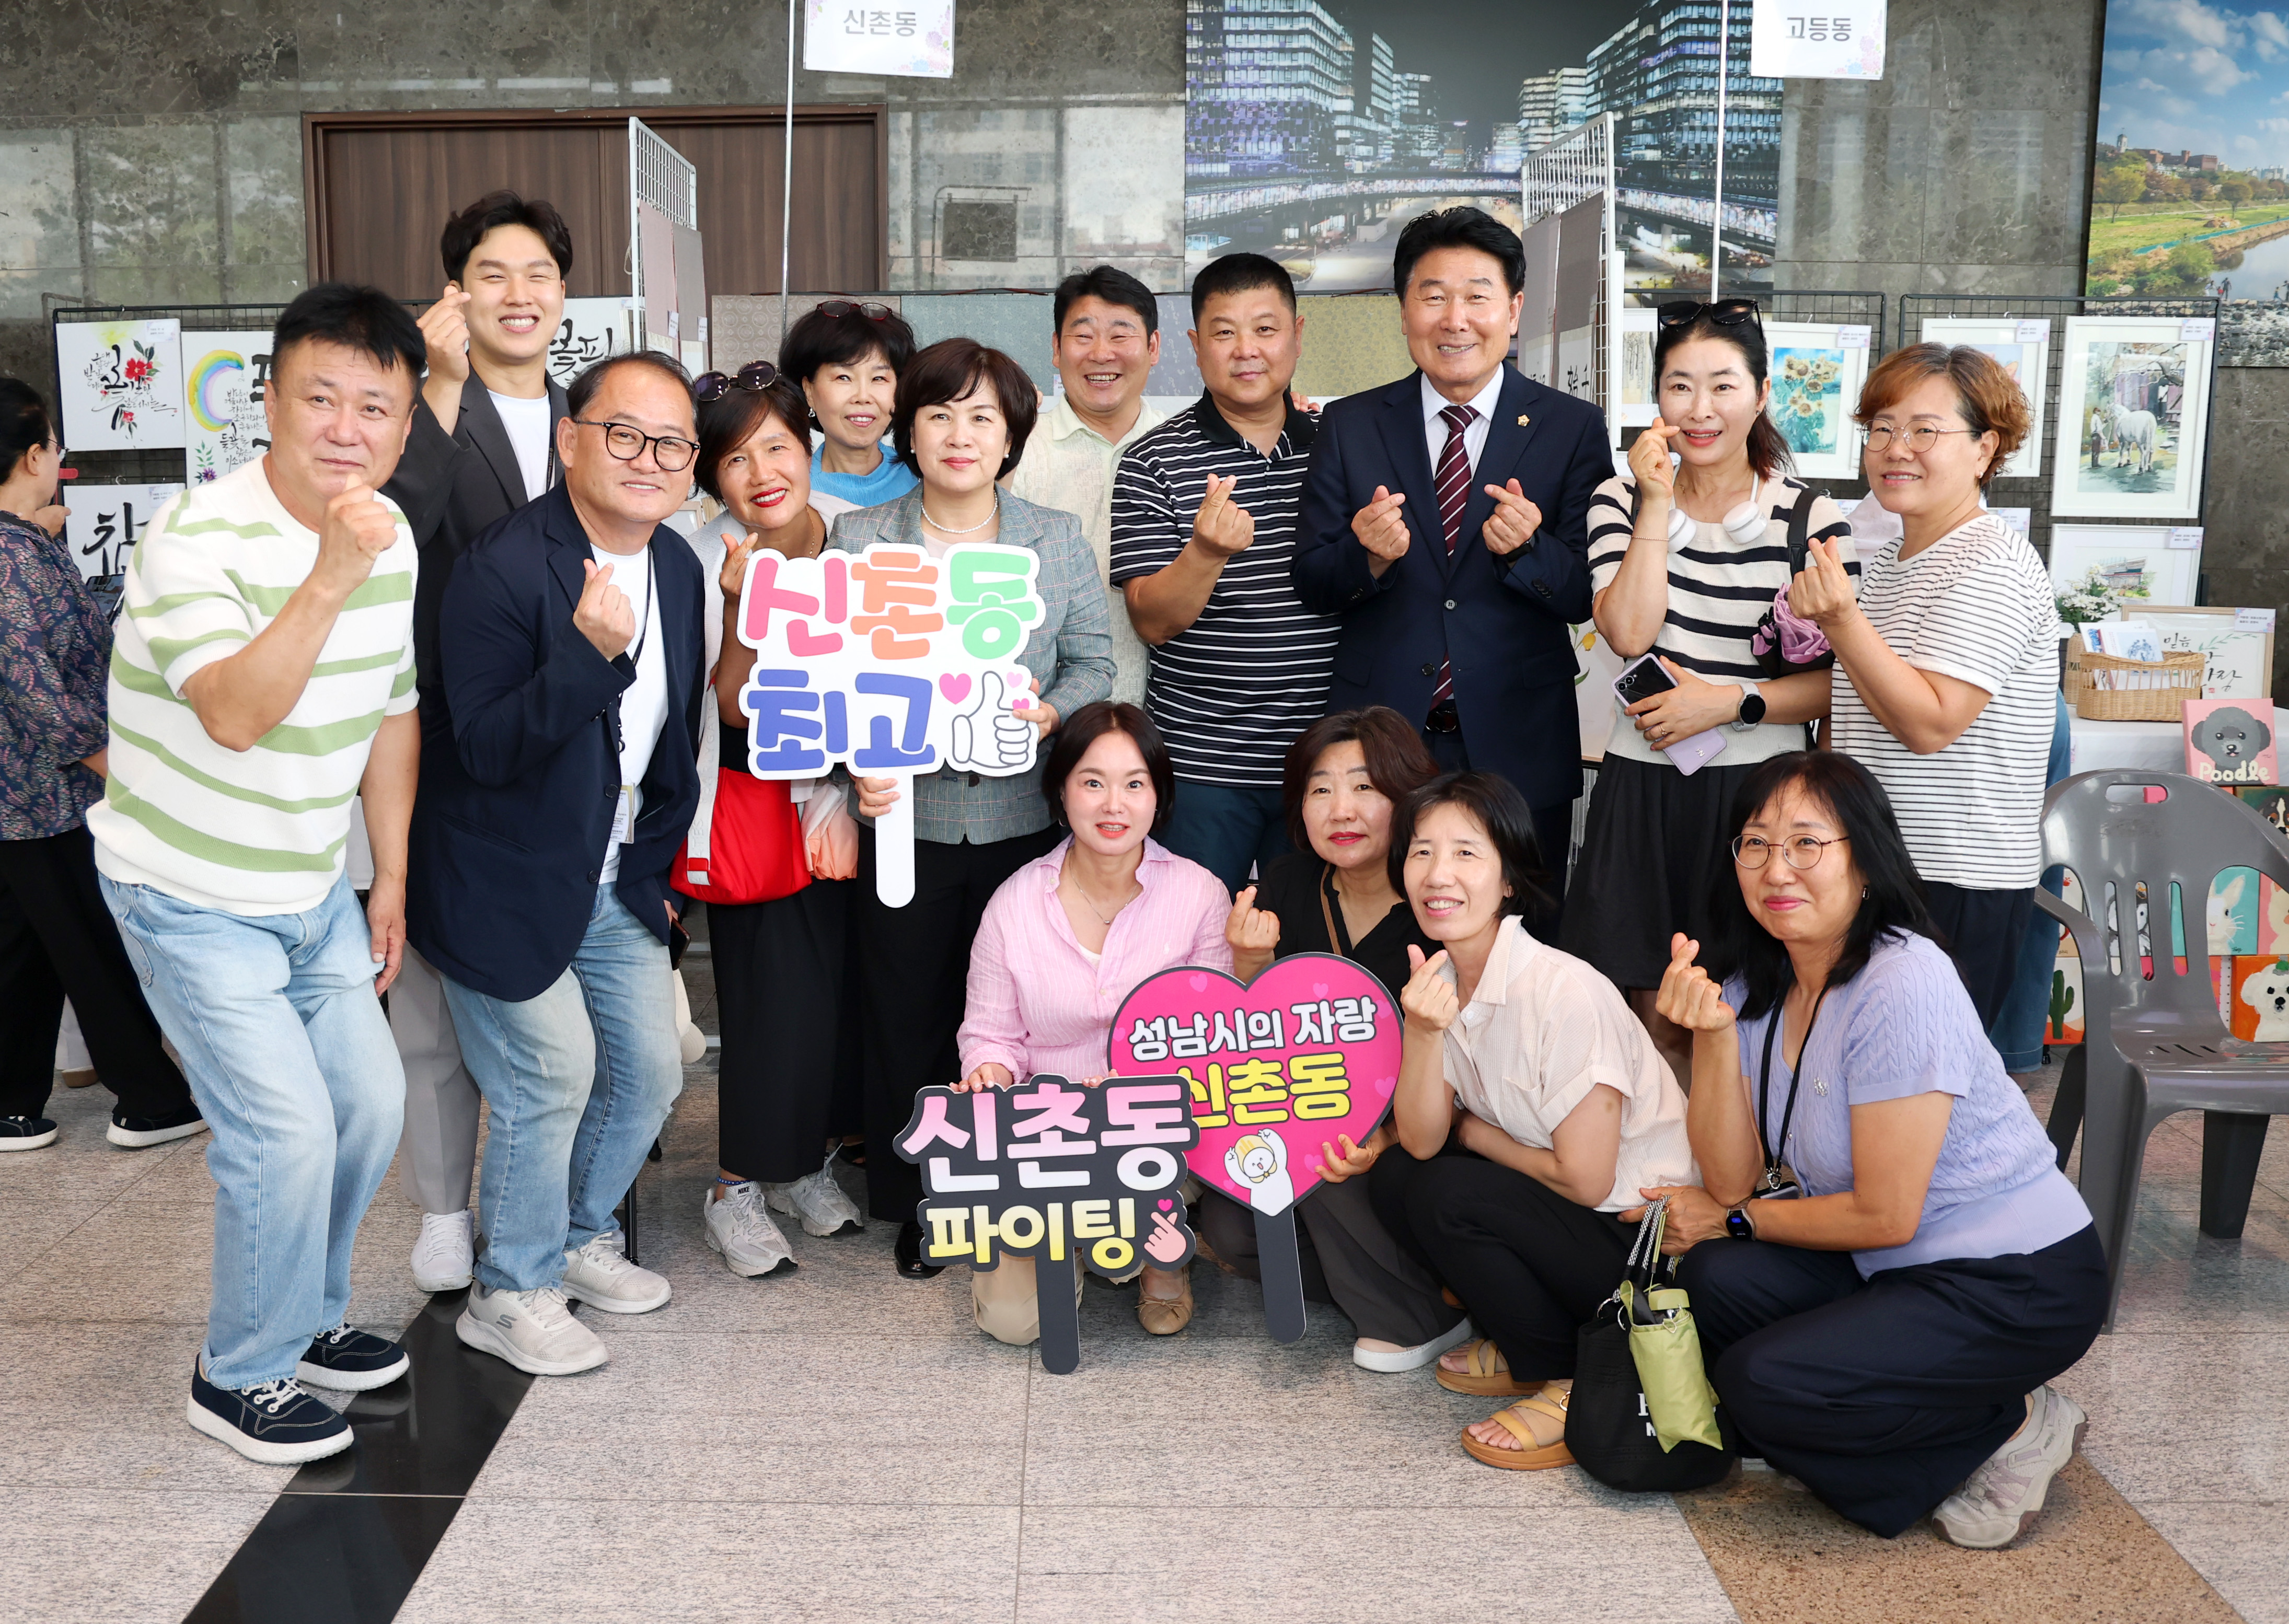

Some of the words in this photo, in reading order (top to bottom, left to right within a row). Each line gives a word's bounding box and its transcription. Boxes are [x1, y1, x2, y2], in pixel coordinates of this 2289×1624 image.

[843, 9, 917, 37] 신촌동
[1785, 17, 1852, 41] 고등동
[746, 551, 1037, 660] 신촌동
[747, 669, 935, 771] 최고
[2199, 760, 2271, 782] Poodle
[1129, 1008, 1284, 1062] 성남시의
[1290, 996, 1377, 1046] 자랑
[1178, 1052, 1351, 1129] 신촌동
[902, 1083, 1191, 1193] 신촌동
[737, 1186, 750, 1195] NIKE
[926, 1197, 1136, 1270] 파이팅
